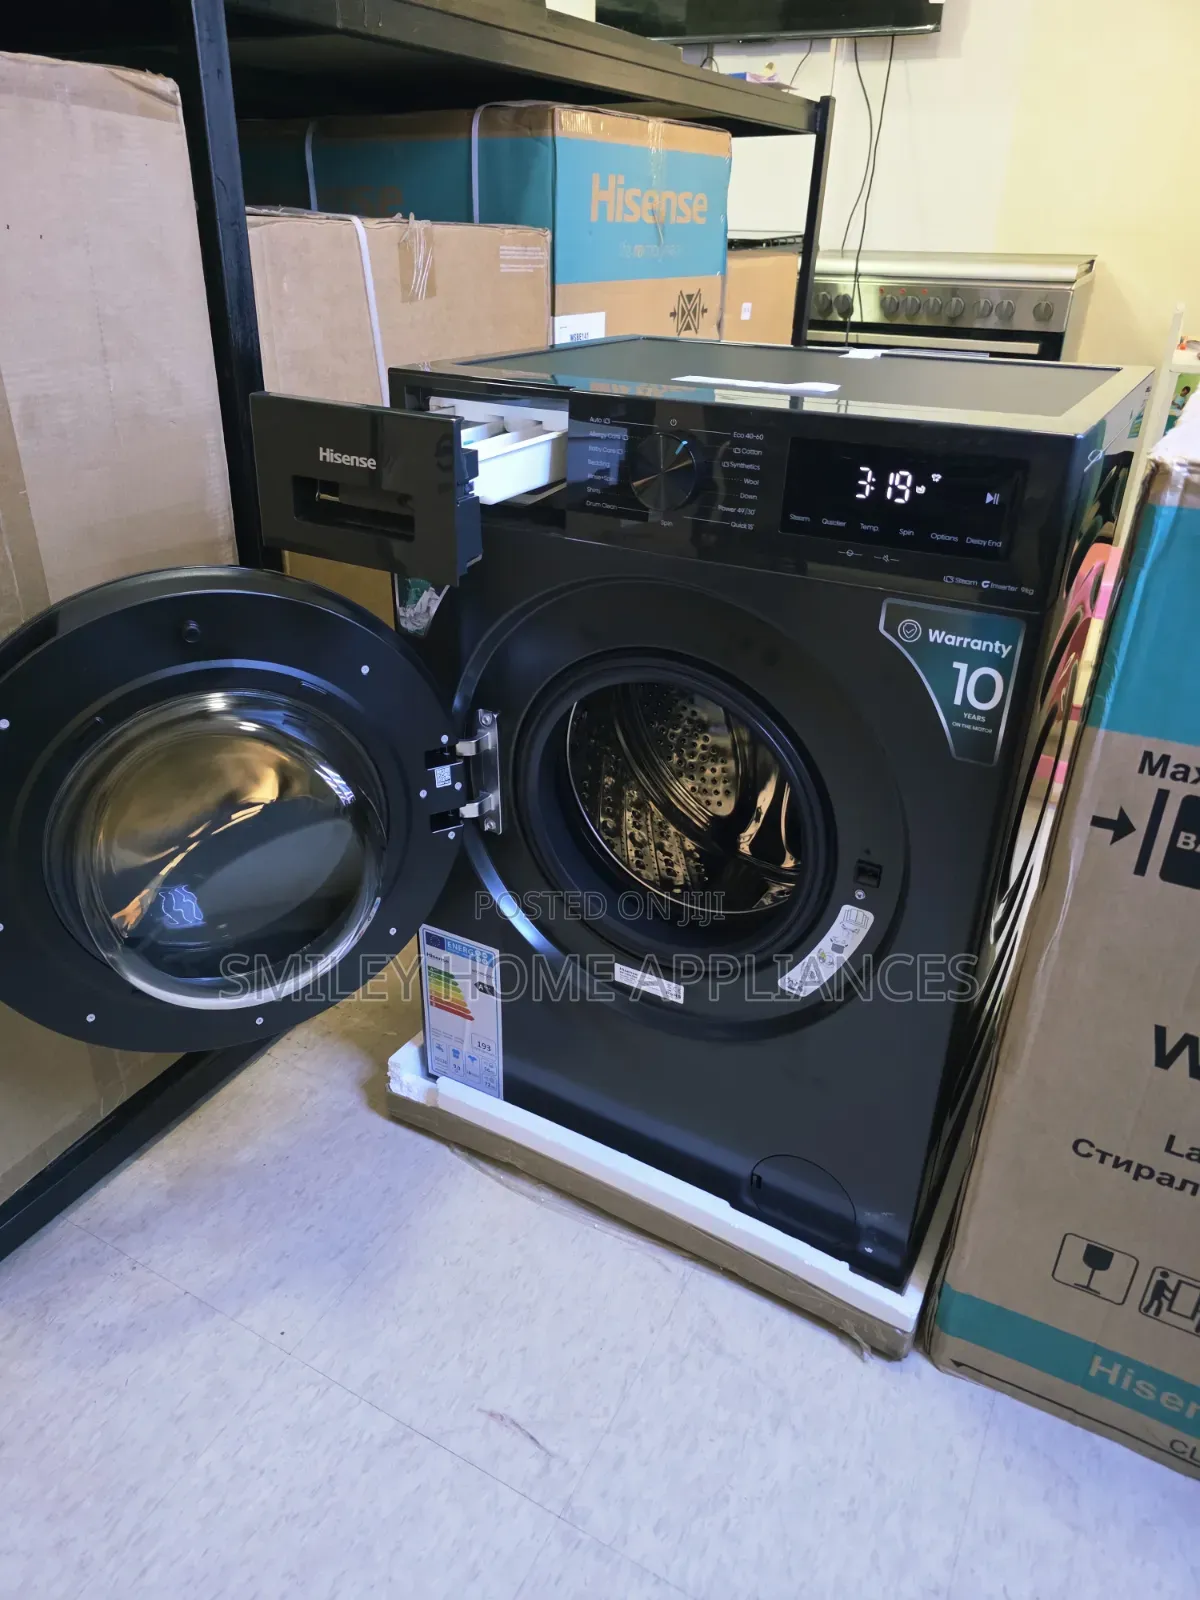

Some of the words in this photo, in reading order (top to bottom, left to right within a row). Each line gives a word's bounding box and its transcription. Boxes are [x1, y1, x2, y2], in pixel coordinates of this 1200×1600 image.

[590, 173, 708, 225] Hisense
[589, 416, 603, 424] Auto
[733, 431, 745, 439] Eco
[745, 433, 764, 441] 40-60
[741, 447, 762, 456] Cotton
[319, 446, 377, 470] Hisense
[587, 458, 611, 468] Bedding
[729, 460, 761, 471] Synthetics
[743, 477, 760, 486] Wool
[855, 466, 912, 504] 3:19
[739, 492, 758, 500] Down
[585, 500, 601, 509] Drum
[601, 502, 618, 511] Clean
[717, 504, 736, 513] Power
[660, 519, 674, 528] Spin
[730, 521, 747, 530] Quick
[789, 513, 811, 523] Steam
[821, 517, 847, 528] Quicker
[899, 528, 915, 537] Spin
[930, 532, 959, 543] Options
[965, 536, 988, 547] Delay
[988, 539, 1003, 548] End
[954, 577, 978, 587] Steam
[990, 582, 1018, 592] Inverter
[928, 628, 1013, 659] Warranty
[952, 661, 1004, 711] 10
[963, 712, 987, 723] YEARS
[972, 725, 993, 734] MOTOR
[477, 1041, 492, 1052] 193
